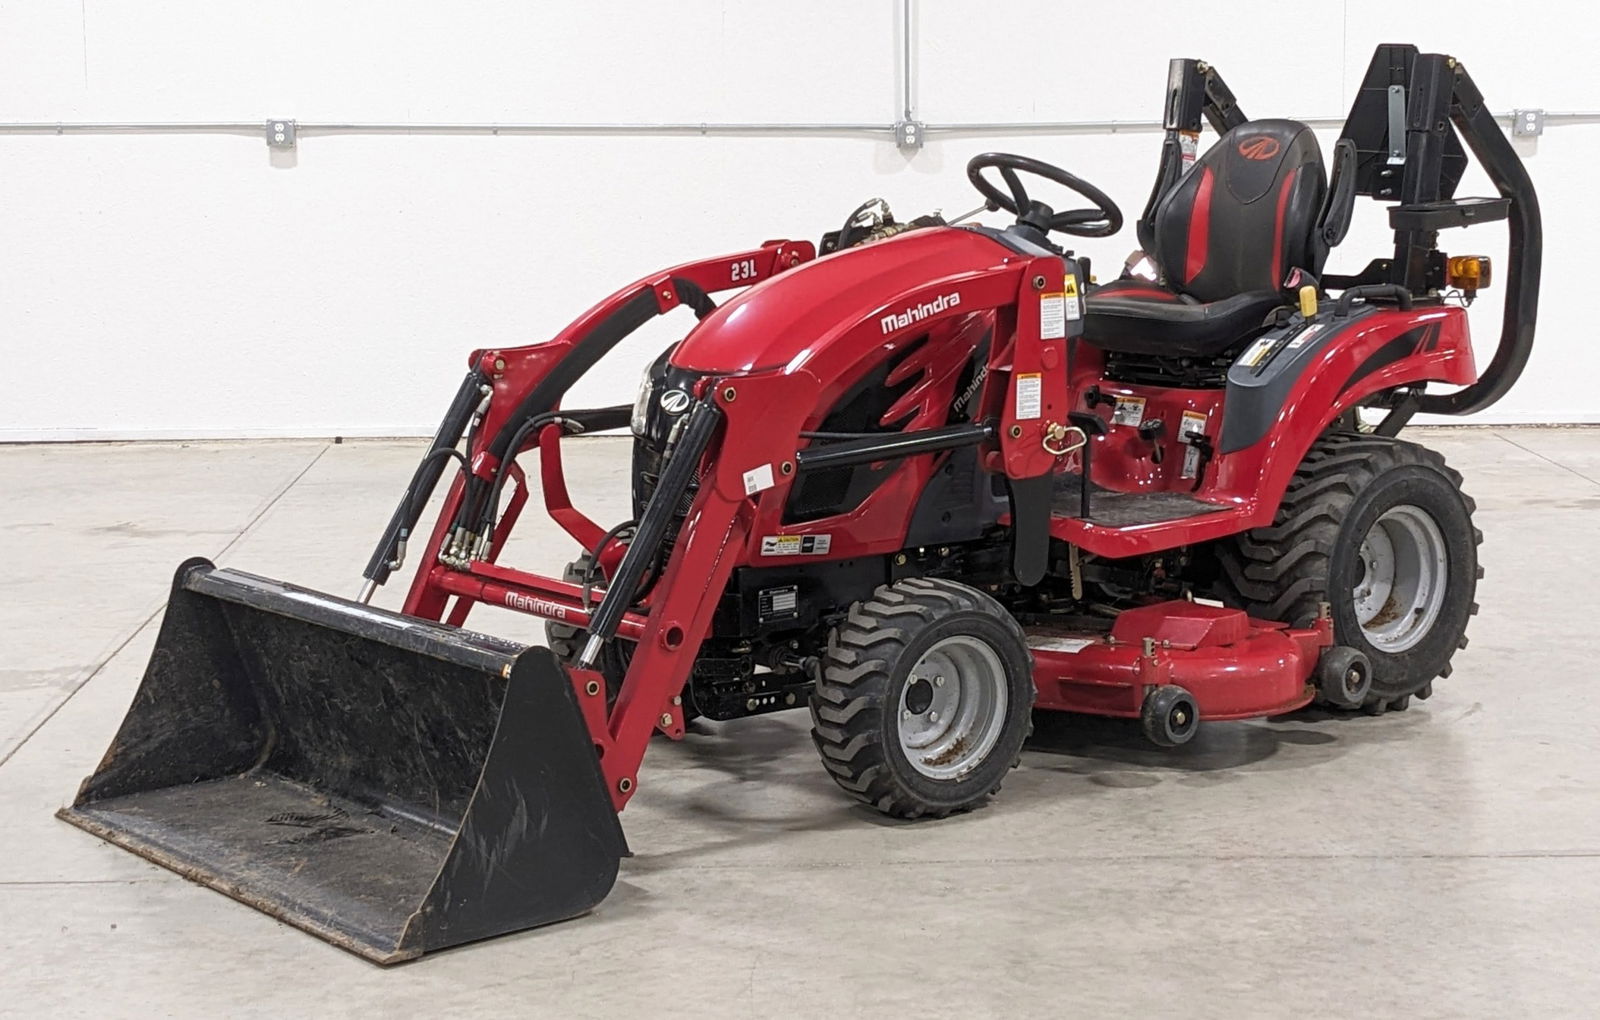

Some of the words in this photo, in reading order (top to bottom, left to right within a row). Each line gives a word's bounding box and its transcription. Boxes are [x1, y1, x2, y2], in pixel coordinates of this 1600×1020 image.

[731, 259, 757, 281] 23L
[881, 292, 961, 334] Mahindra
[505, 591, 566, 618] Mahindra
